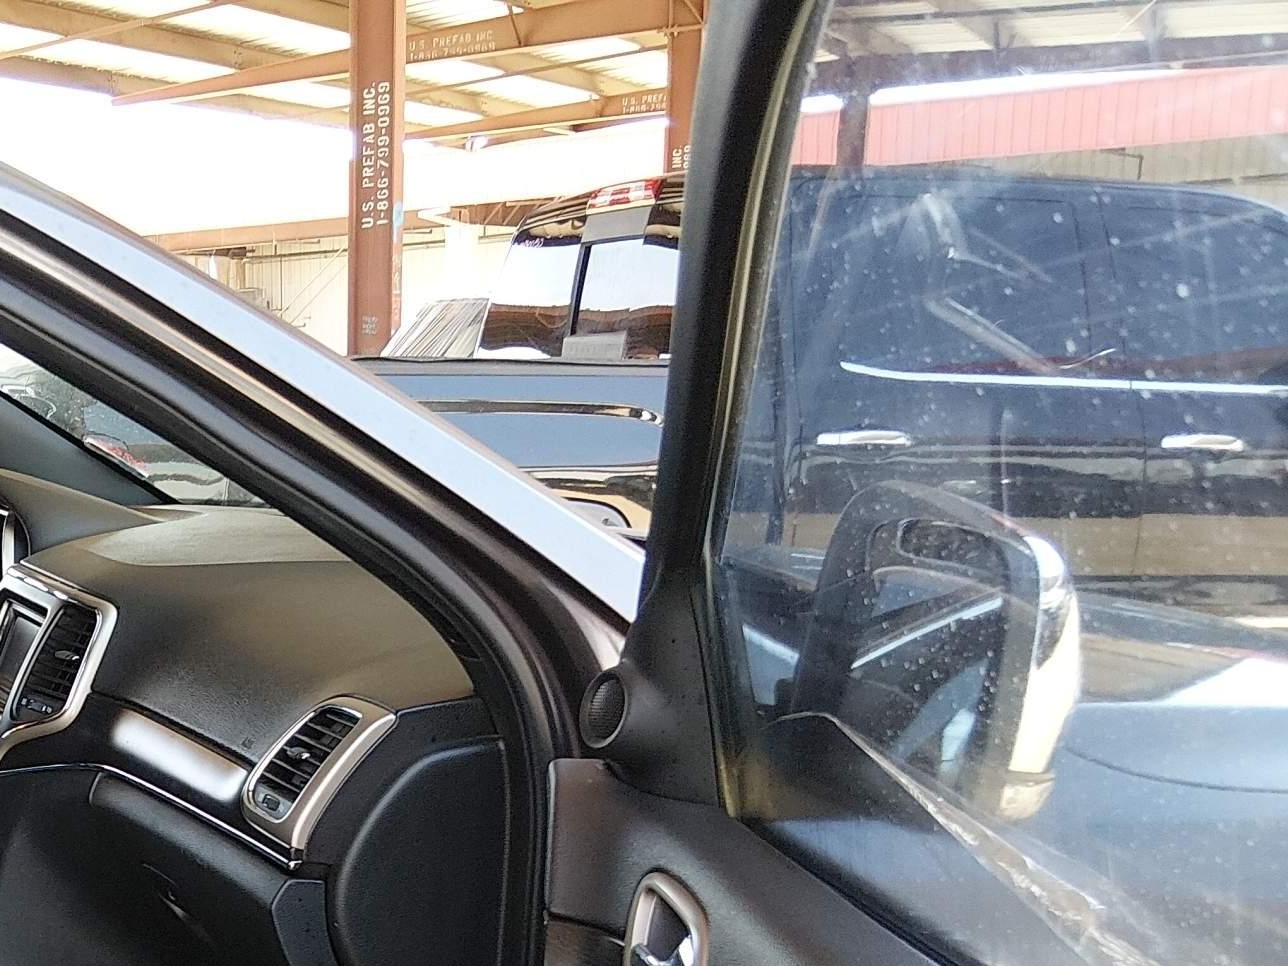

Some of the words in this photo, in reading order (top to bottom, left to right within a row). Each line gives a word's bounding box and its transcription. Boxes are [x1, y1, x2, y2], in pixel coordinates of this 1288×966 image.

[363, 81, 376, 115] INC.
[363, 123, 375, 188] PREFAB
[376, 82, 390, 225] 1-866-799-0969
